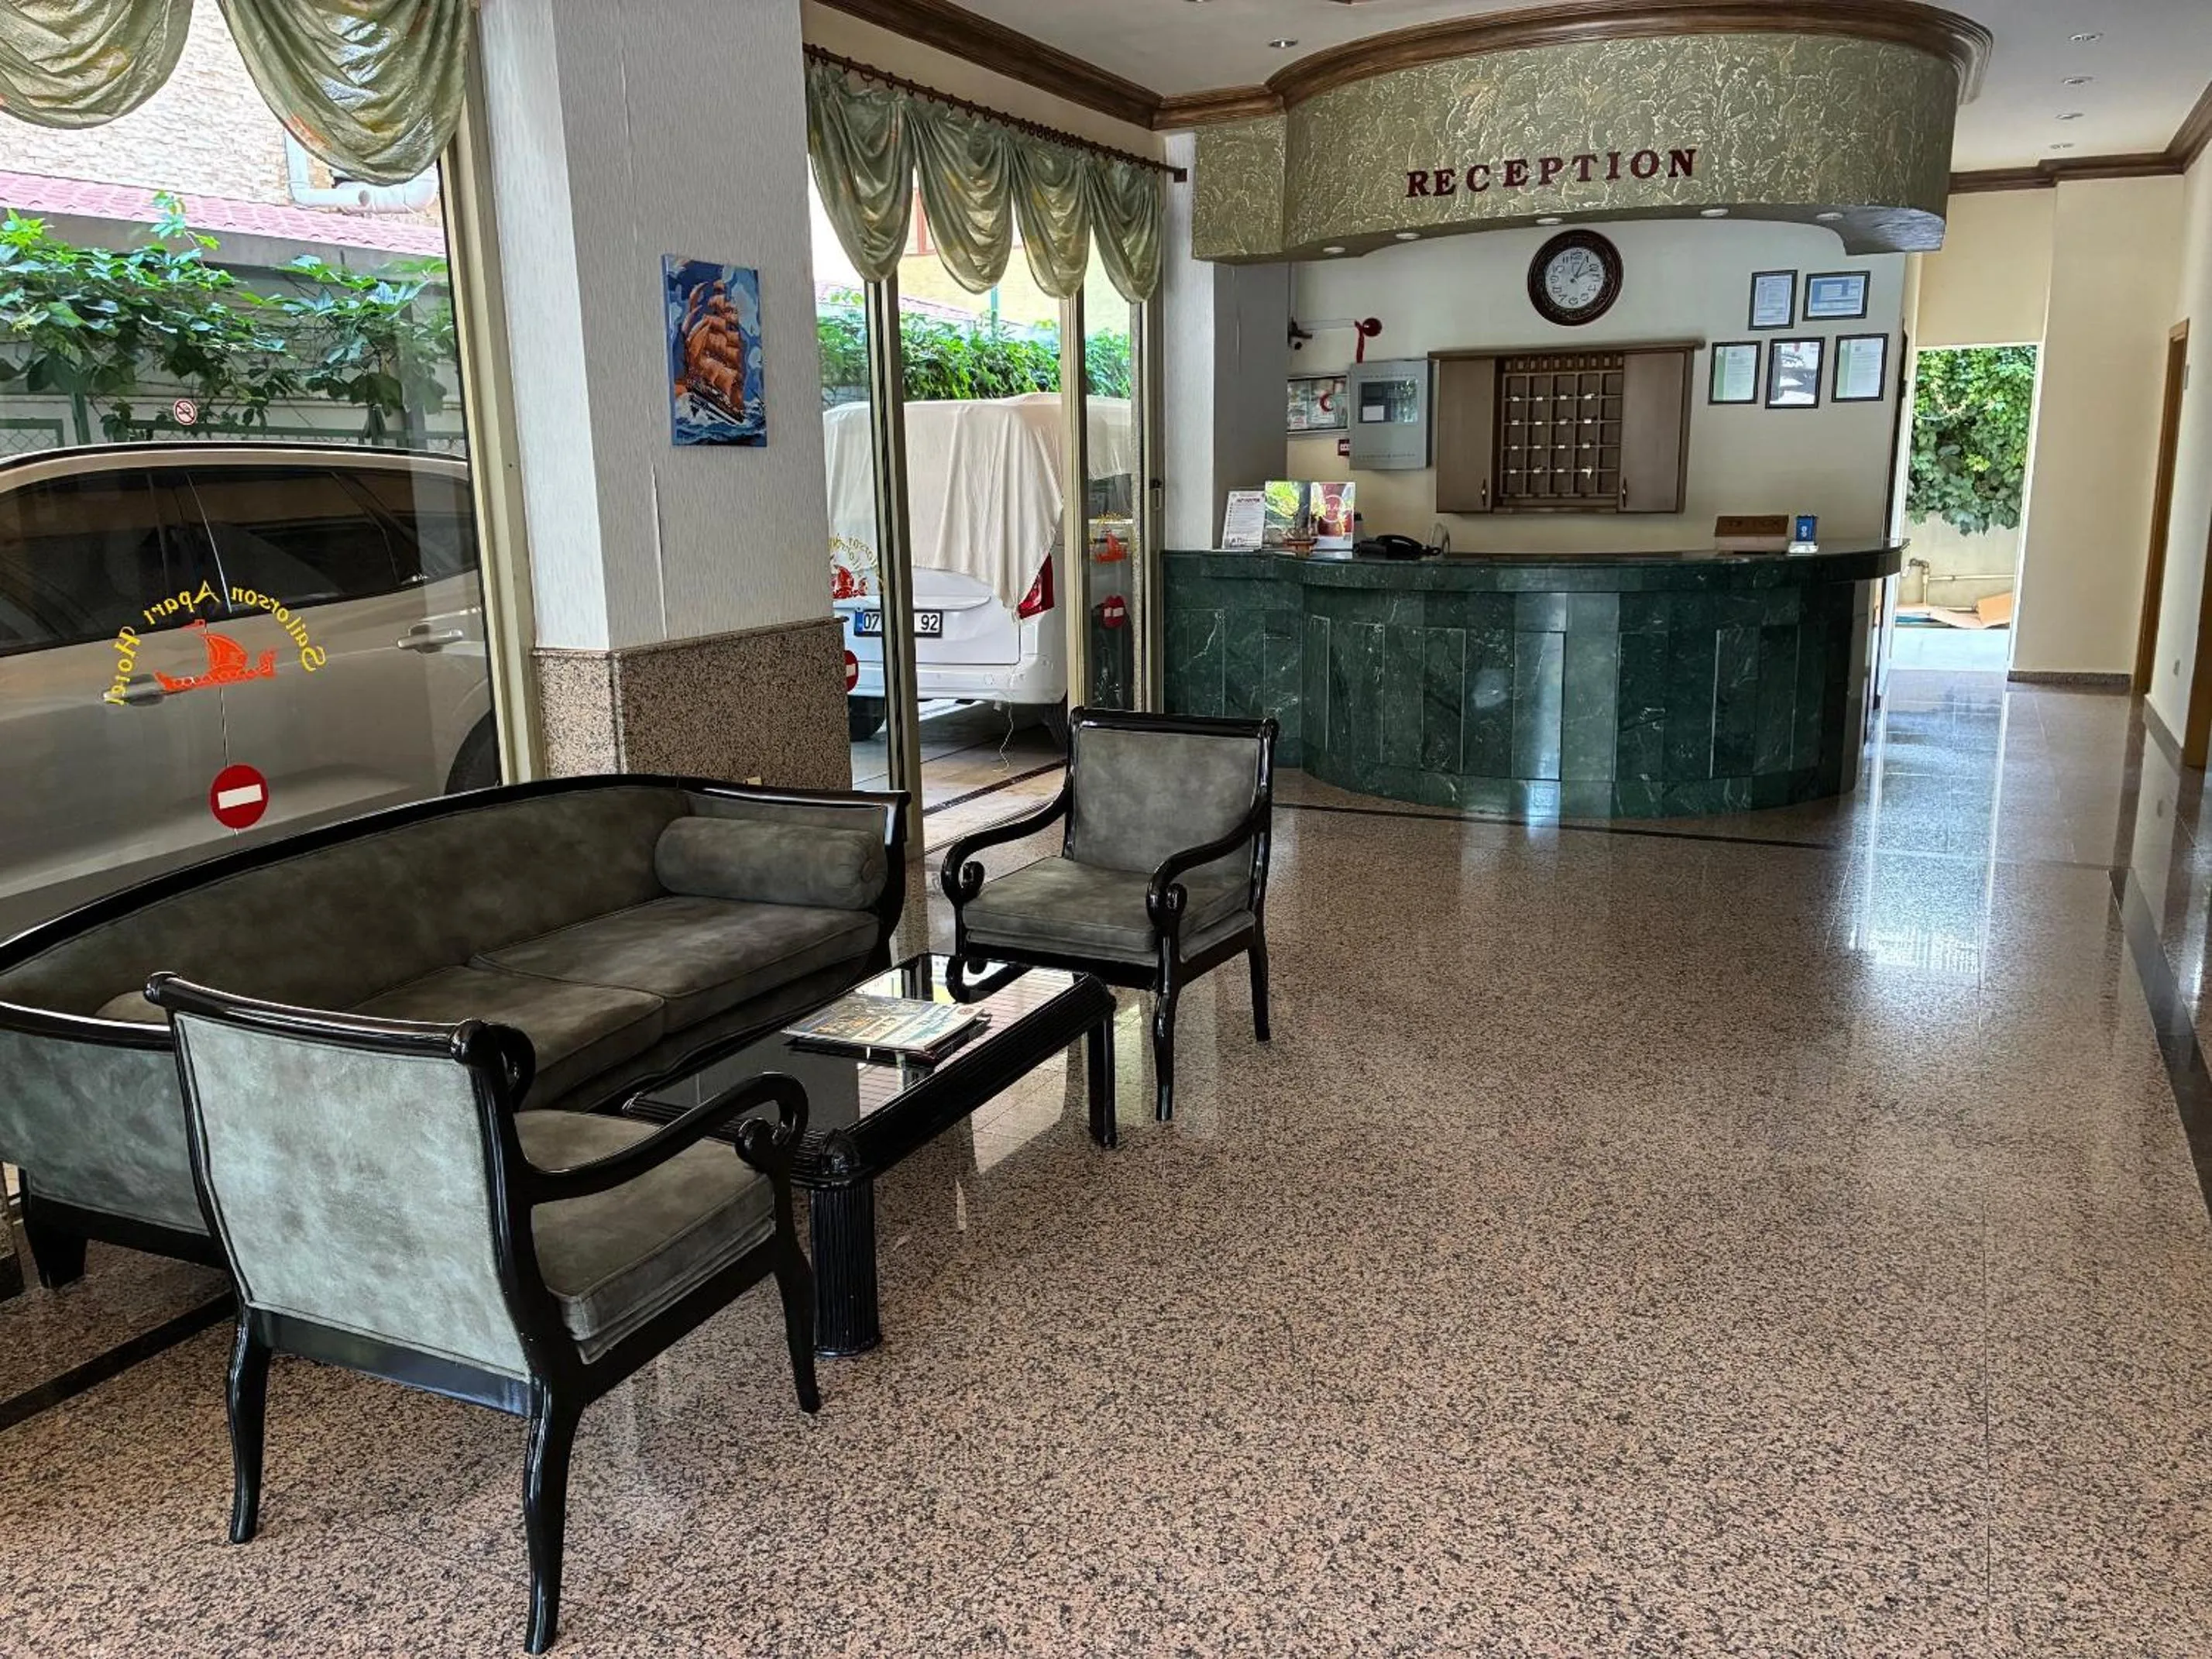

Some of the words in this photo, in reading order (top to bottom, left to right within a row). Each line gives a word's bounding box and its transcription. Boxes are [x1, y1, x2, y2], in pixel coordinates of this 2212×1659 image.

[1406, 148, 1697, 198] RECEPTION
[863, 613, 881, 630] 07
[920, 613, 939, 631] 92
